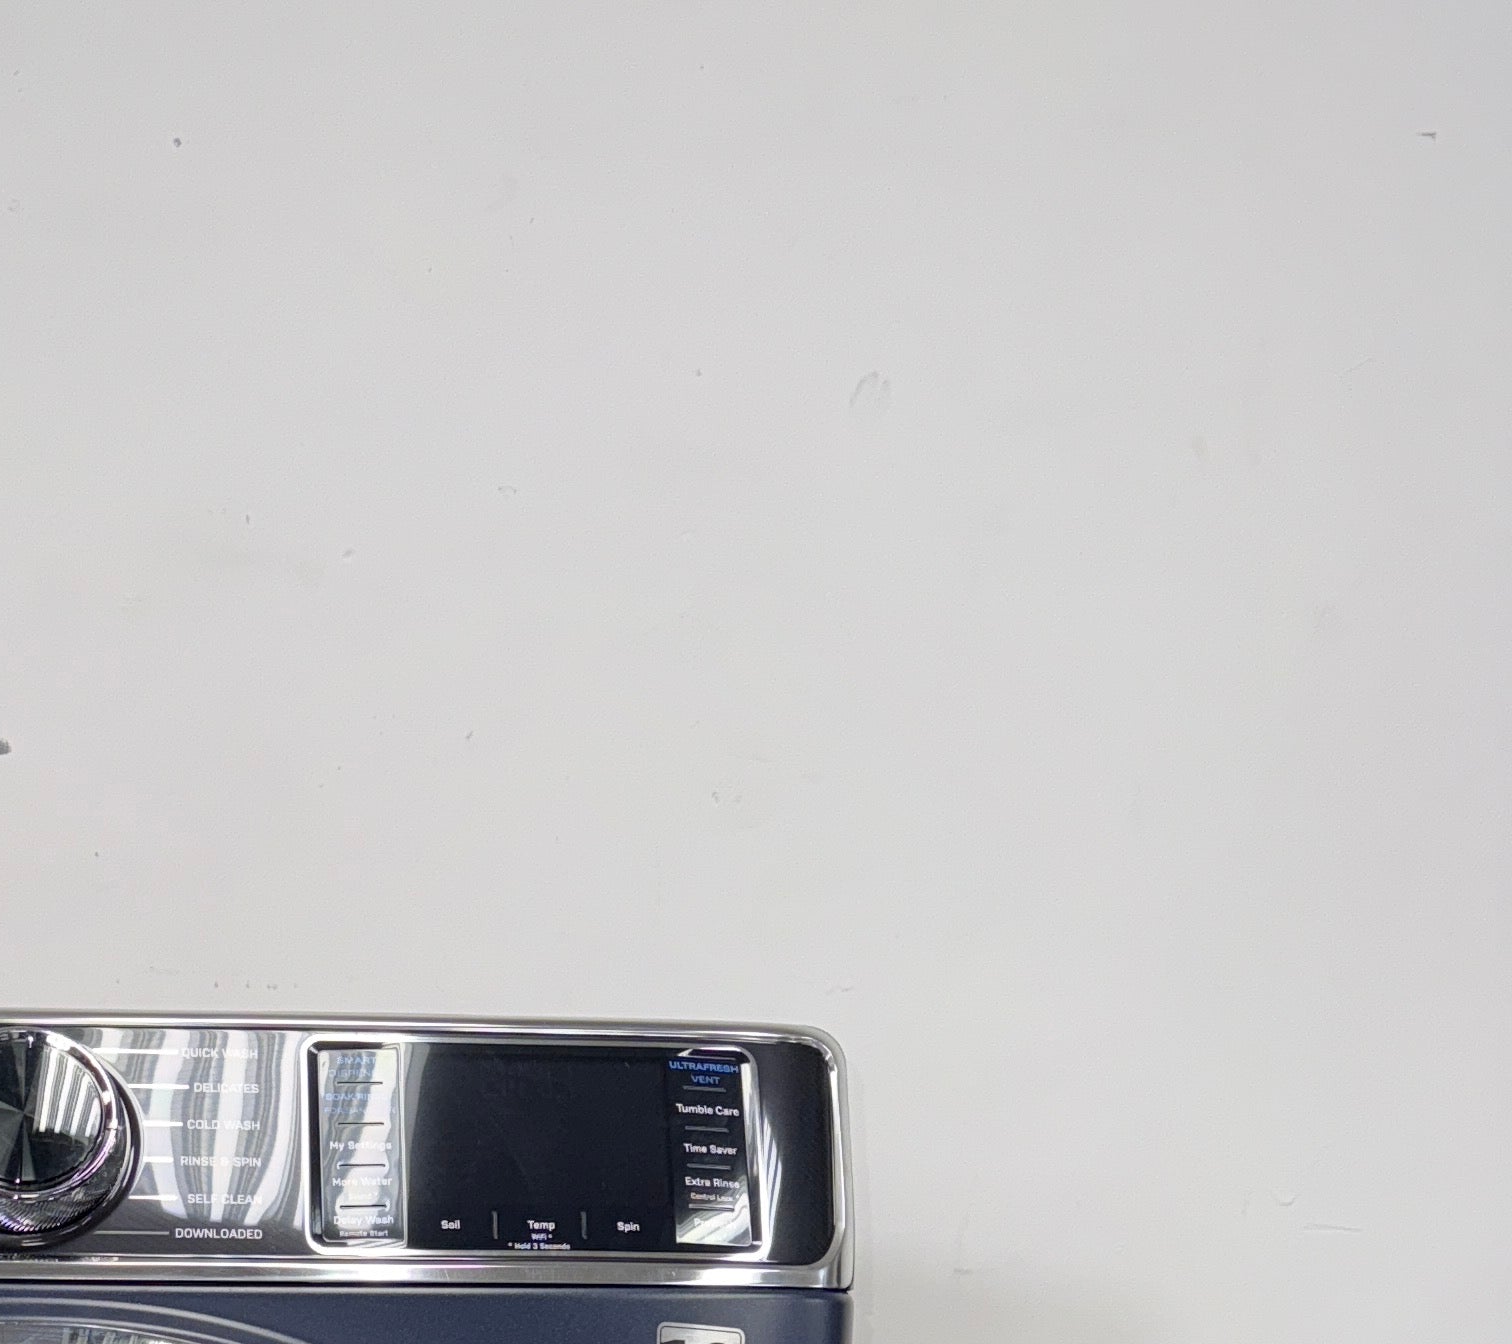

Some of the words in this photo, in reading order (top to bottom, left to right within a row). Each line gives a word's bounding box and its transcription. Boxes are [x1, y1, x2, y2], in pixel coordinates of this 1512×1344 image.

[182, 1047, 219, 1059] QUICK
[669, 1060, 739, 1074] ULTRAFRESH
[690, 1074, 721, 1085] VENT
[675, 1103, 714, 1115] Tumble
[715, 1105, 740, 1117] Care
[187, 1119, 220, 1130] COLD
[223, 1120, 261, 1131] WASH
[329, 1140, 345, 1152] My
[683, 1143, 708, 1154] Time
[709, 1144, 738, 1155] Saver
[180, 1155, 217, 1167] RINSE
[233, 1156, 262, 1168] SPIN
[684, 1176, 711, 1187] Extra
[713, 1178, 740, 1189] Rinse
[441, 1219, 461, 1230] Soil
[527, 1219, 556, 1232] Temp
[616, 1221, 640, 1233] Spin
[174, 1227, 264, 1240] DOWNLOADED
